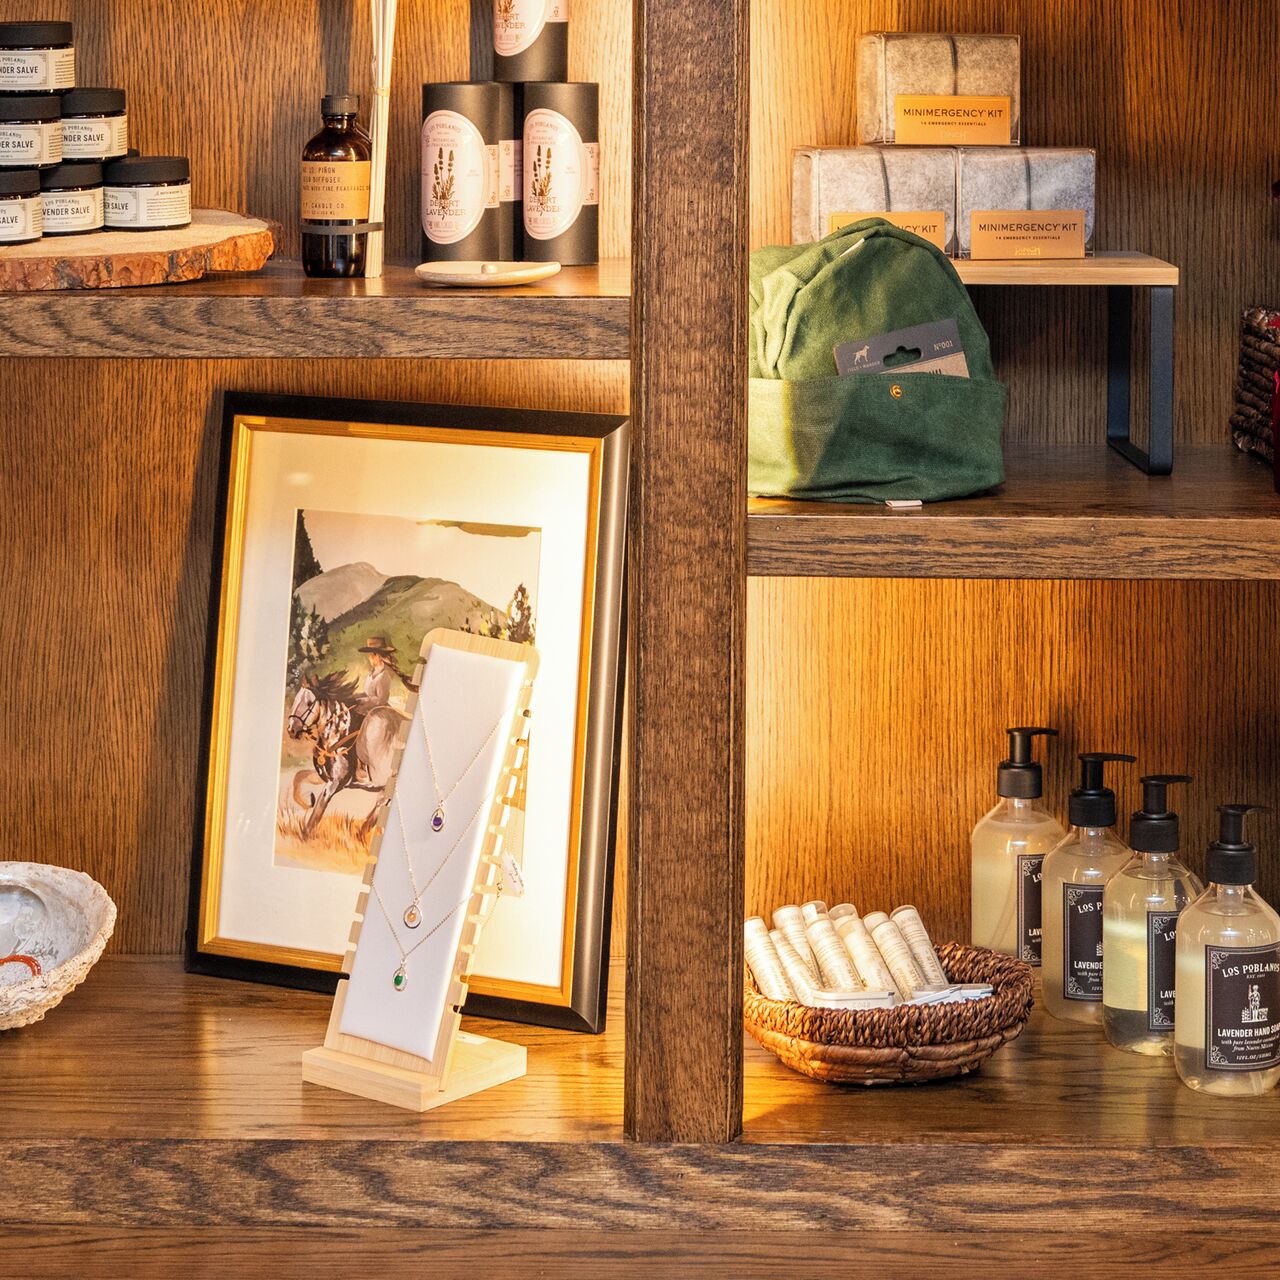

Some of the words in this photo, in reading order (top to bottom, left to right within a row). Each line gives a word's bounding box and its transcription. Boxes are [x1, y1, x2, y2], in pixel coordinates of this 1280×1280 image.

[16, 66, 38, 74] SALVE
[903, 108, 984, 118] MINIMERGENCY
[988, 108, 1003, 118] KIT
[11, 140, 34, 148] SALVE
[979, 223, 1058, 233] MINIMERGENCY
[1062, 223, 1077, 232] KIT
[1222, 967, 1239, 978] LOS
[1242, 963, 1280, 974] POBLANOS
[1218, 1028, 1253, 1037] LAVENDER
[1254, 1027, 1270, 1037] HAND
